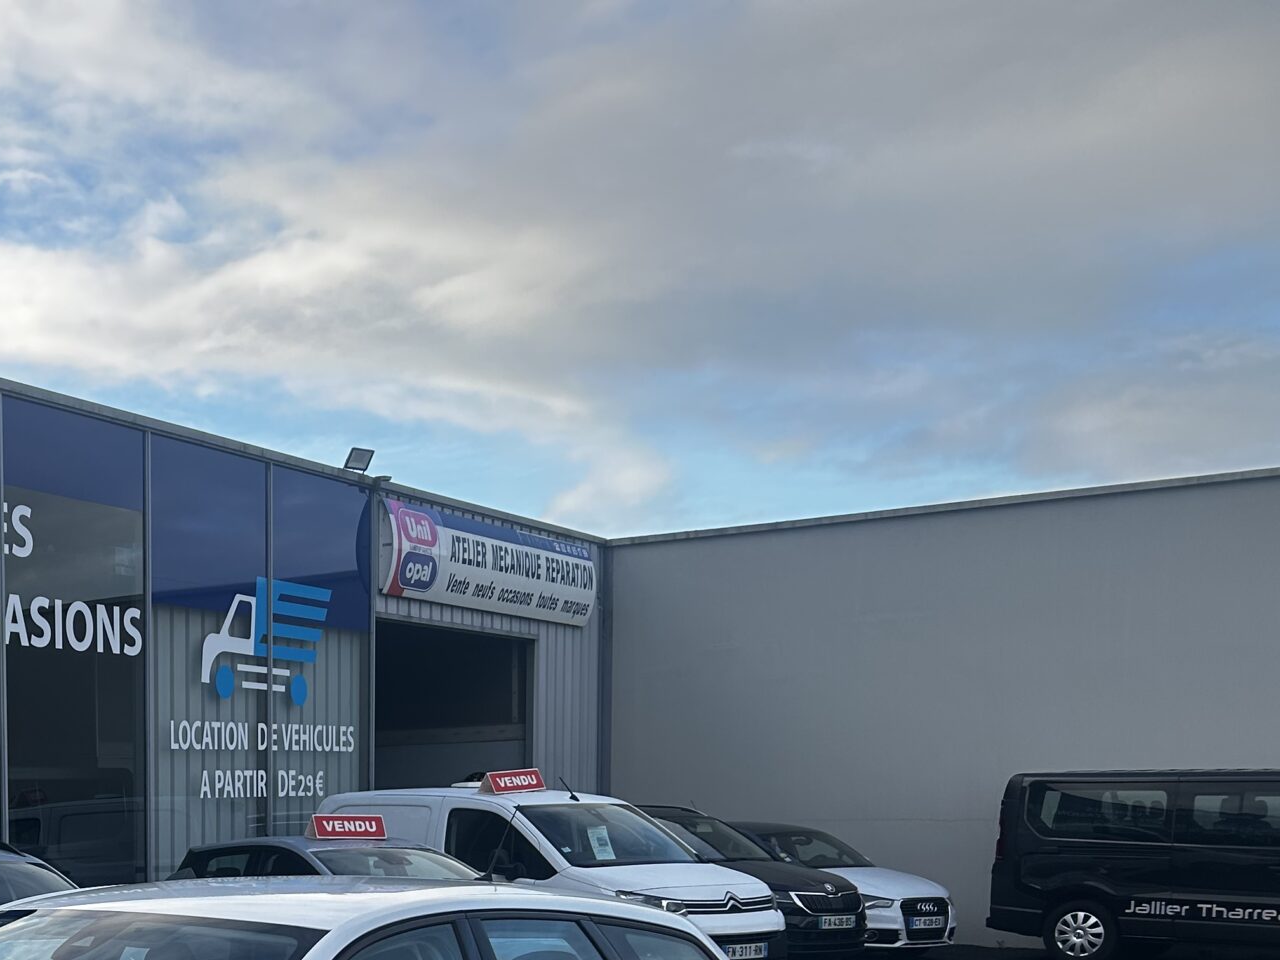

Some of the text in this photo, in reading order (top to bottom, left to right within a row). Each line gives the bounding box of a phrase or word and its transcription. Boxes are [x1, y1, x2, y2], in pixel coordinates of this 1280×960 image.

[405, 516, 432, 541] Unil
[405, 561, 433, 584] opal
[449, 535, 487, 569] ATELIER
[491, 544, 542, 580] MECANIQUE
[545, 556, 594, 592] REPARATION
[445, 572, 470, 595] Vente
[497, 587, 534, 607] occasions
[535, 592, 559, 612] toutes
[560, 600, 590, 621] marques
[170, 720, 355, 752] LOCATION DE VEHICULES
[199, 769, 212, 799] A
[214, 769, 268, 798] PARTIR
[277, 769, 297, 797] DE
[496, 774, 538, 788] VENDU
[322, 819, 377, 833] VENDU
[1124, 900, 1280, 921] Jallier Tharre
